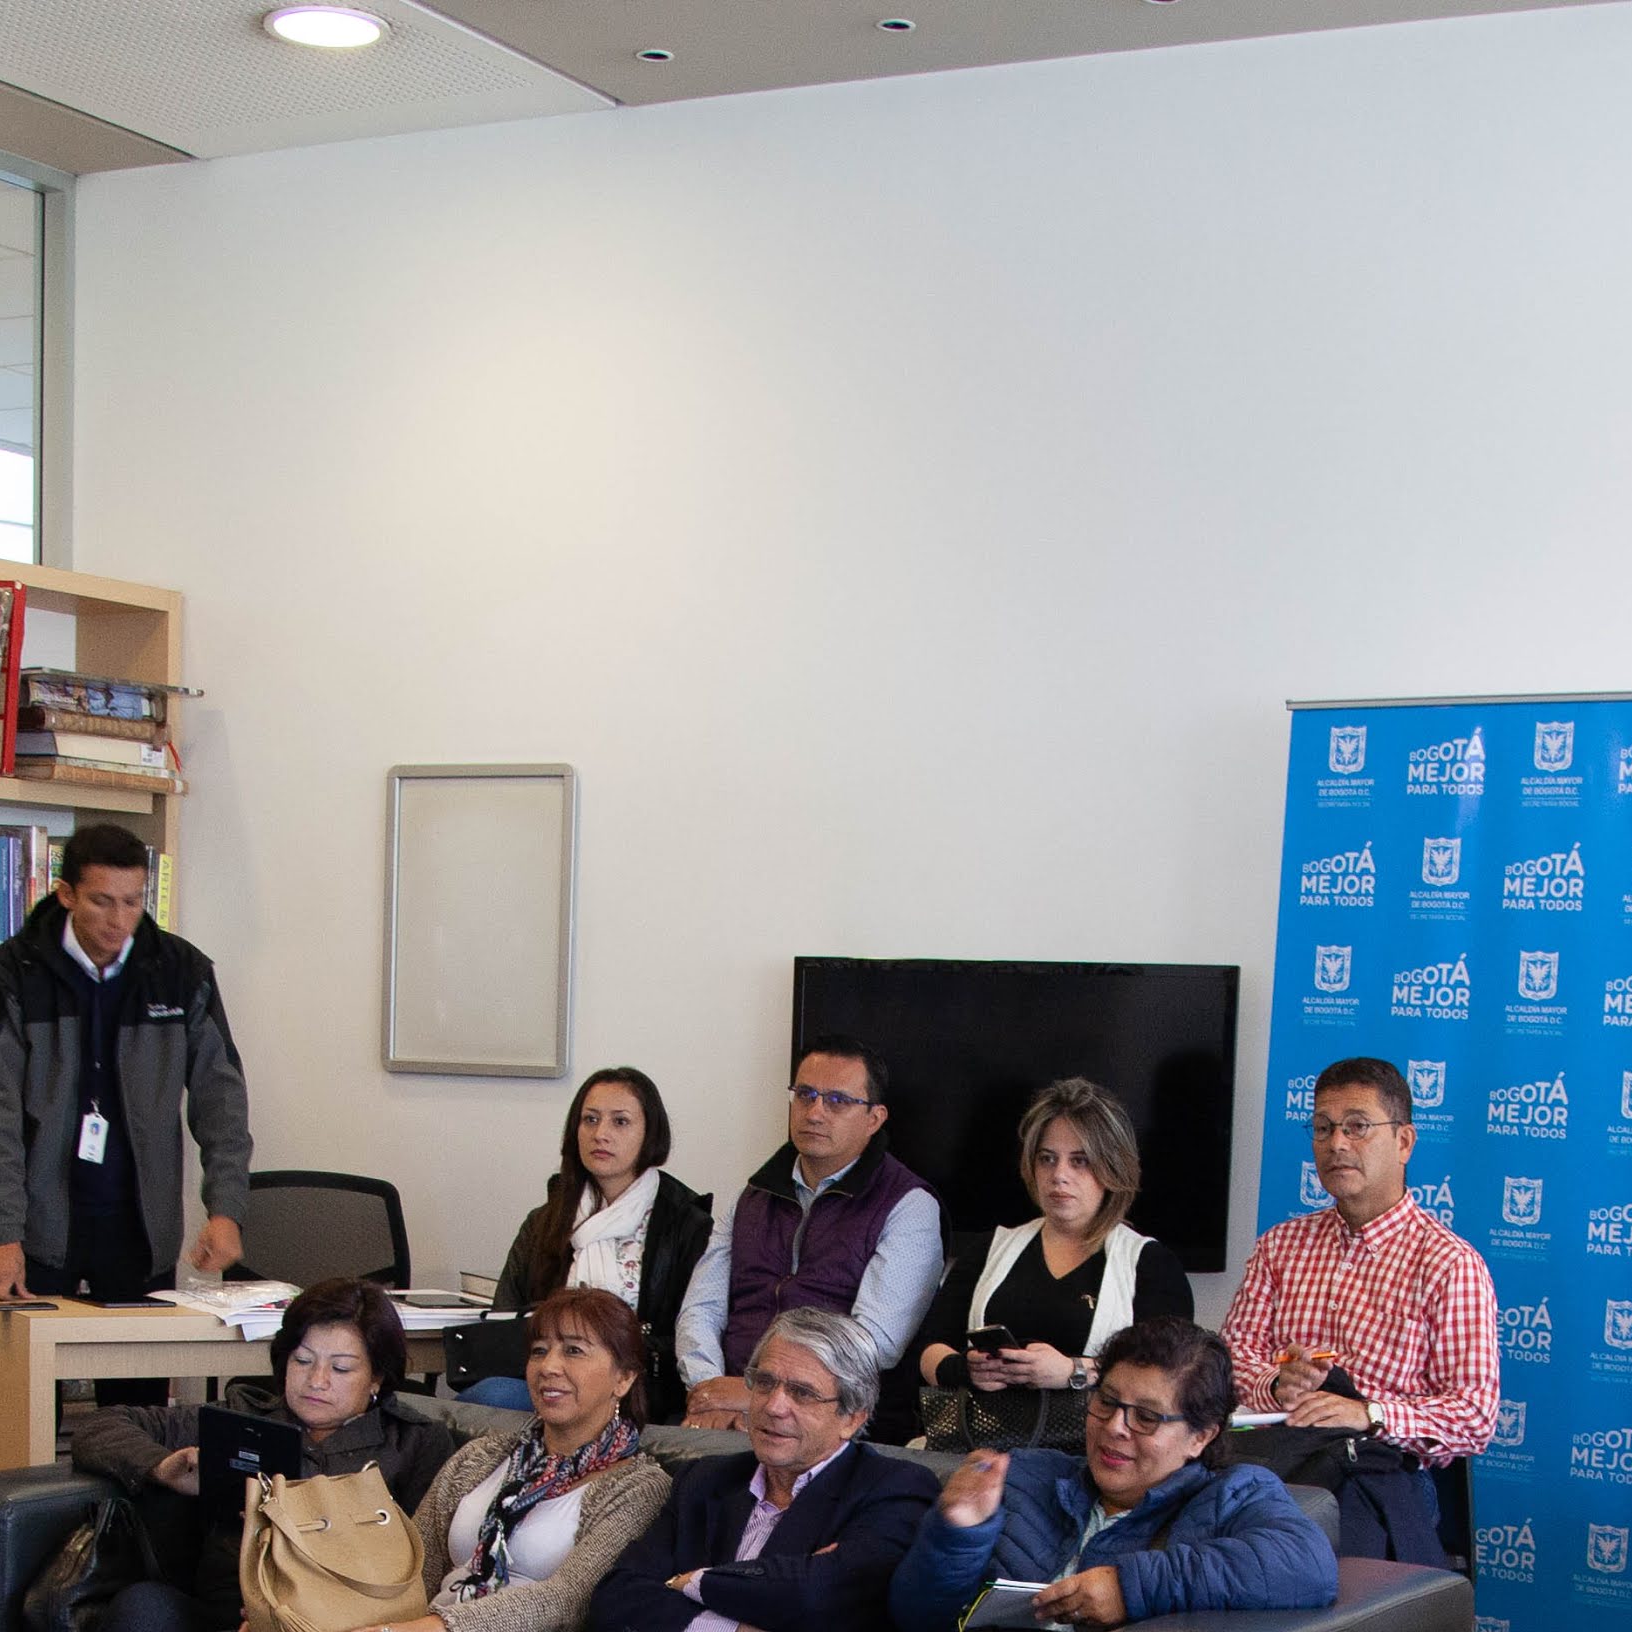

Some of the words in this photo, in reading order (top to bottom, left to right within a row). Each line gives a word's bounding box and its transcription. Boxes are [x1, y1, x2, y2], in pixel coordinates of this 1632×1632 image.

[1409, 726, 1485, 761] BOGOTÁ
[1408, 763, 1485, 782] MEJOR
[1407, 785, 1438, 794] PARA
[1442, 784, 1484, 795] TODOS
[1303, 841, 1376, 873] BOGOTÁ
[1505, 842, 1585, 876] BOGOTÁ
[1301, 875, 1375, 894] MEJOR
[1503, 878, 1583, 898] MEJOR
[1300, 896, 1330, 906] PARA
[1334, 896, 1374, 906] TODOS
[1503, 899, 1535, 909] PARA
[1540, 900, 1582, 911] TODOS
[1394, 953, 1470, 985] BOGOTÁ
[1392, 985, 1470, 1006] MEJOR
[1391, 1006, 1421, 1017] PARA
[1426, 1008, 1468, 1020] TODOS
[1288, 1075, 1316, 1089] BOG
[1489, 1072, 1568, 1104] BOGOTÁ
[1488, 1103, 1567, 1126] MEJOR
[1487, 1124, 1519, 1135] PARA
[1524, 1126, 1566, 1139] TODOS
[1412, 1176, 1454, 1208] OTÁ
[1587, 1244, 1621, 1256] PARA
[1497, 1297, 1552, 1330] GOTÁ
[1497, 1327, 1551, 1350] EJOR
[1508, 1350, 1550, 1364] TODOS
[1570, 1468, 1603, 1480] PARA
[1476, 1518, 1535, 1549] GOTÁ
[1476, 1544, 1535, 1570] EJOR
[1491, 1568, 1534, 1583] TODOS
